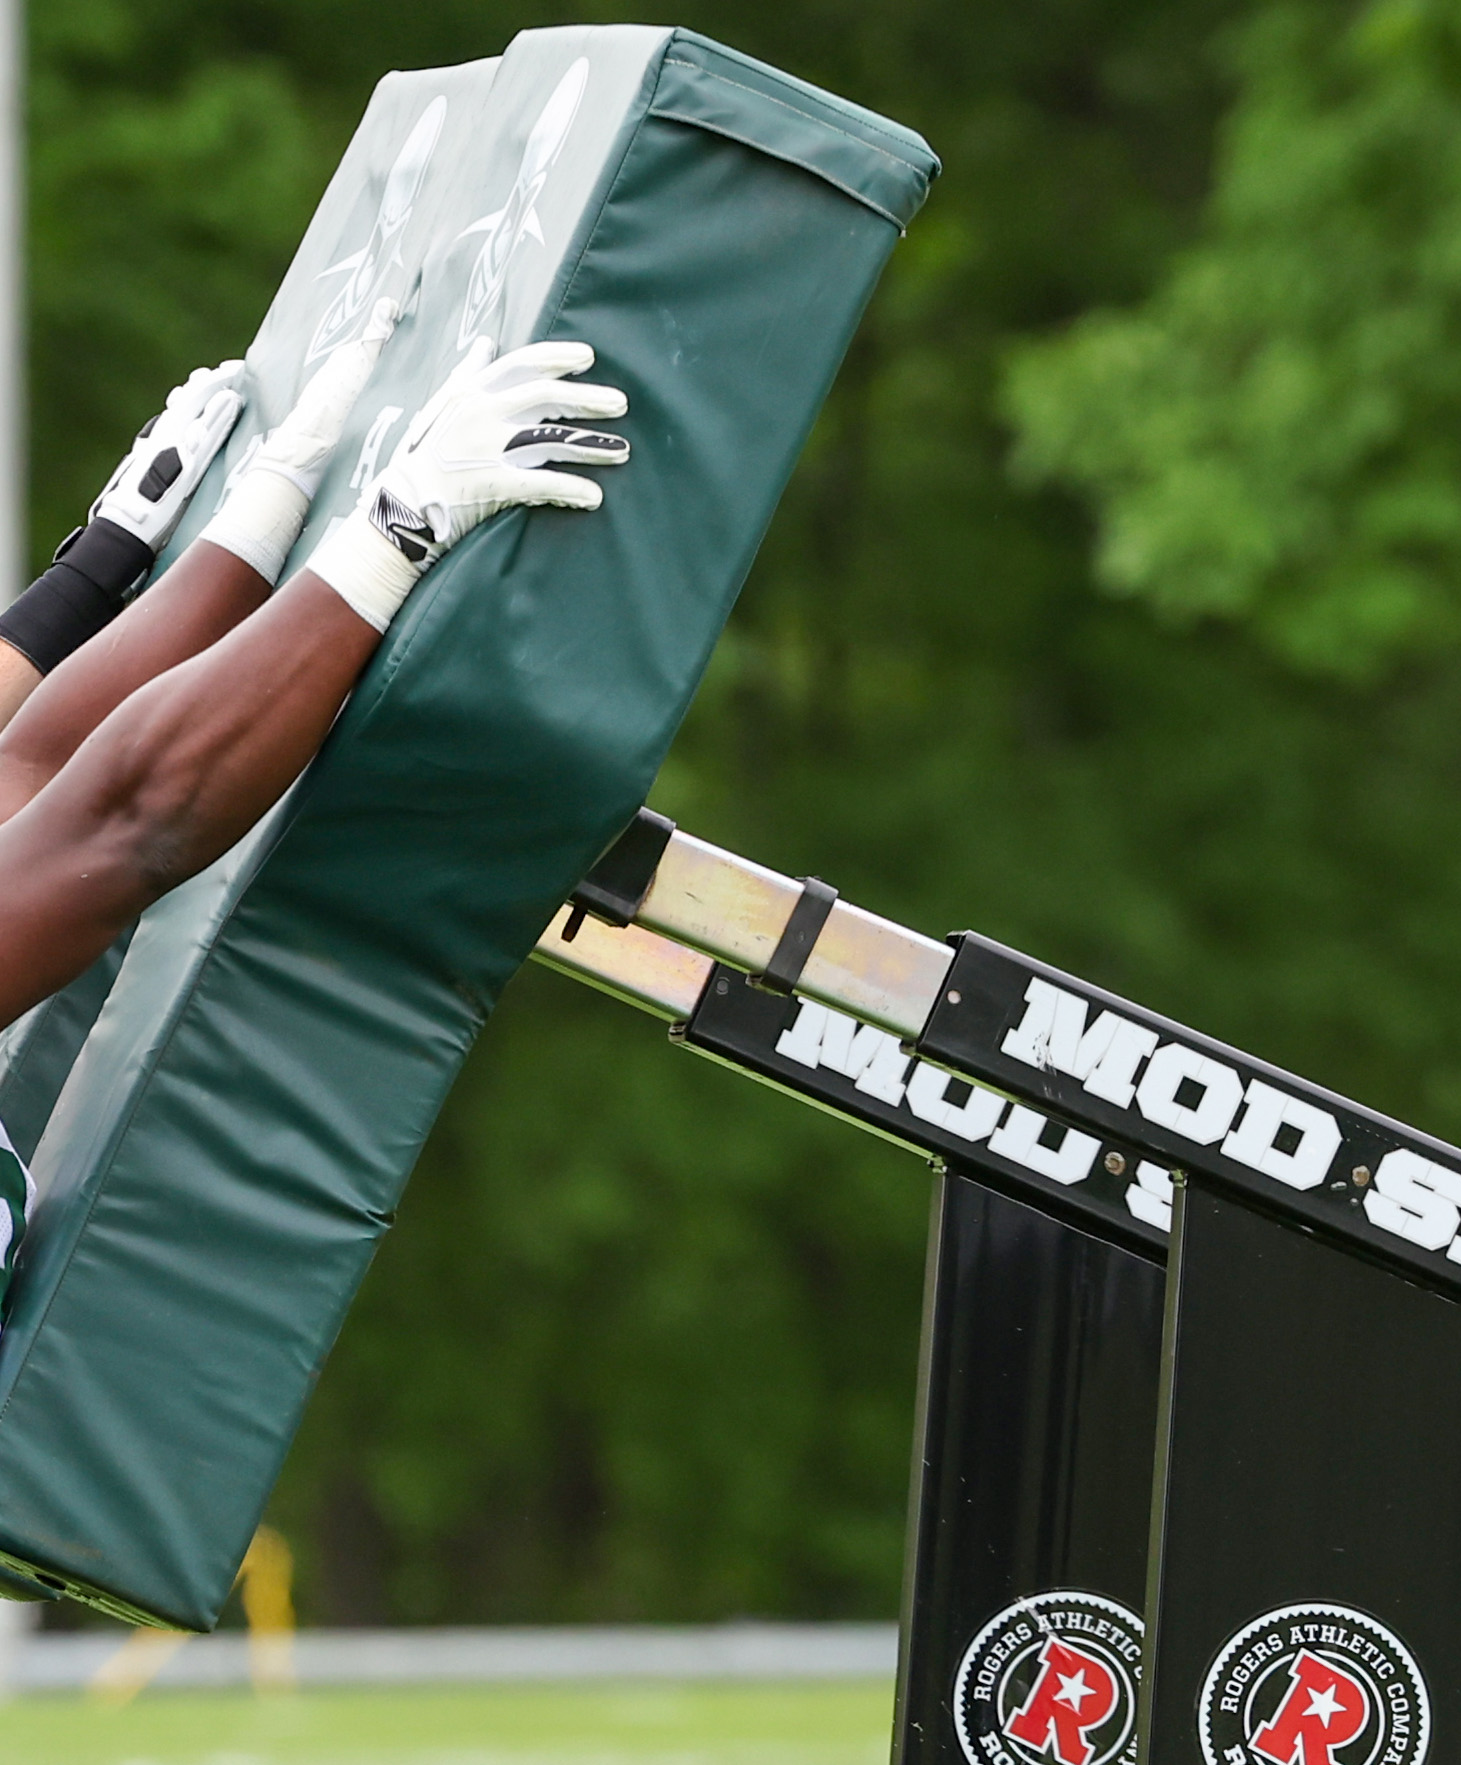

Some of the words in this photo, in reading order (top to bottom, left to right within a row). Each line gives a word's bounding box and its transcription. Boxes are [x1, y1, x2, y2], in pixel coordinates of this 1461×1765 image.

[1000, 976, 1342, 1191] MOD
[974, 1622, 1032, 1701] ROGERS
[1038, 1611, 1141, 1662] ATHLETIC
[1220, 1633, 1283, 1713] ROGERS
[1289, 1624, 1396, 1680] ATHLETIC
